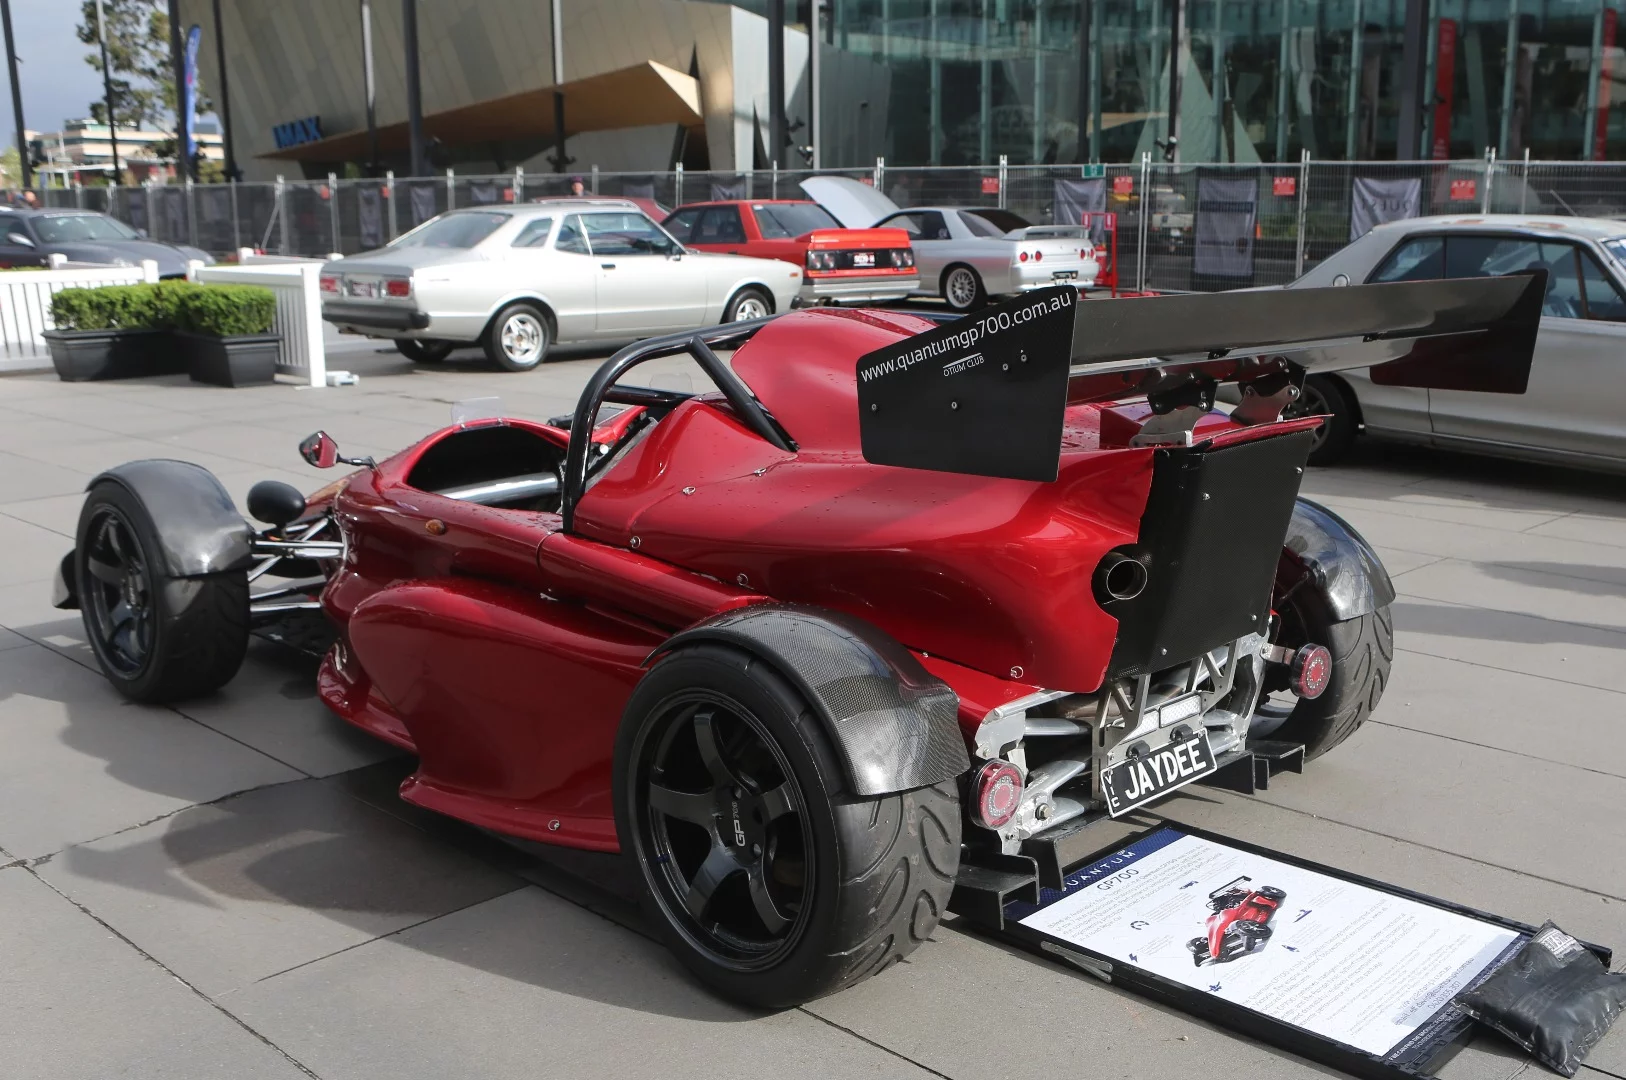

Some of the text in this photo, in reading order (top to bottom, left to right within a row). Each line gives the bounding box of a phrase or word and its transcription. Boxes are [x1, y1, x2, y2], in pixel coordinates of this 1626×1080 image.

[861, 292, 1071, 383] www.quantumgp700.com.au
[943, 355, 985, 377] OTIUM CLUB
[1125, 738, 1207, 800] JAYDEE
[1105, 774, 1120, 808] VIC
[1097, 868, 1139, 890] GP700
